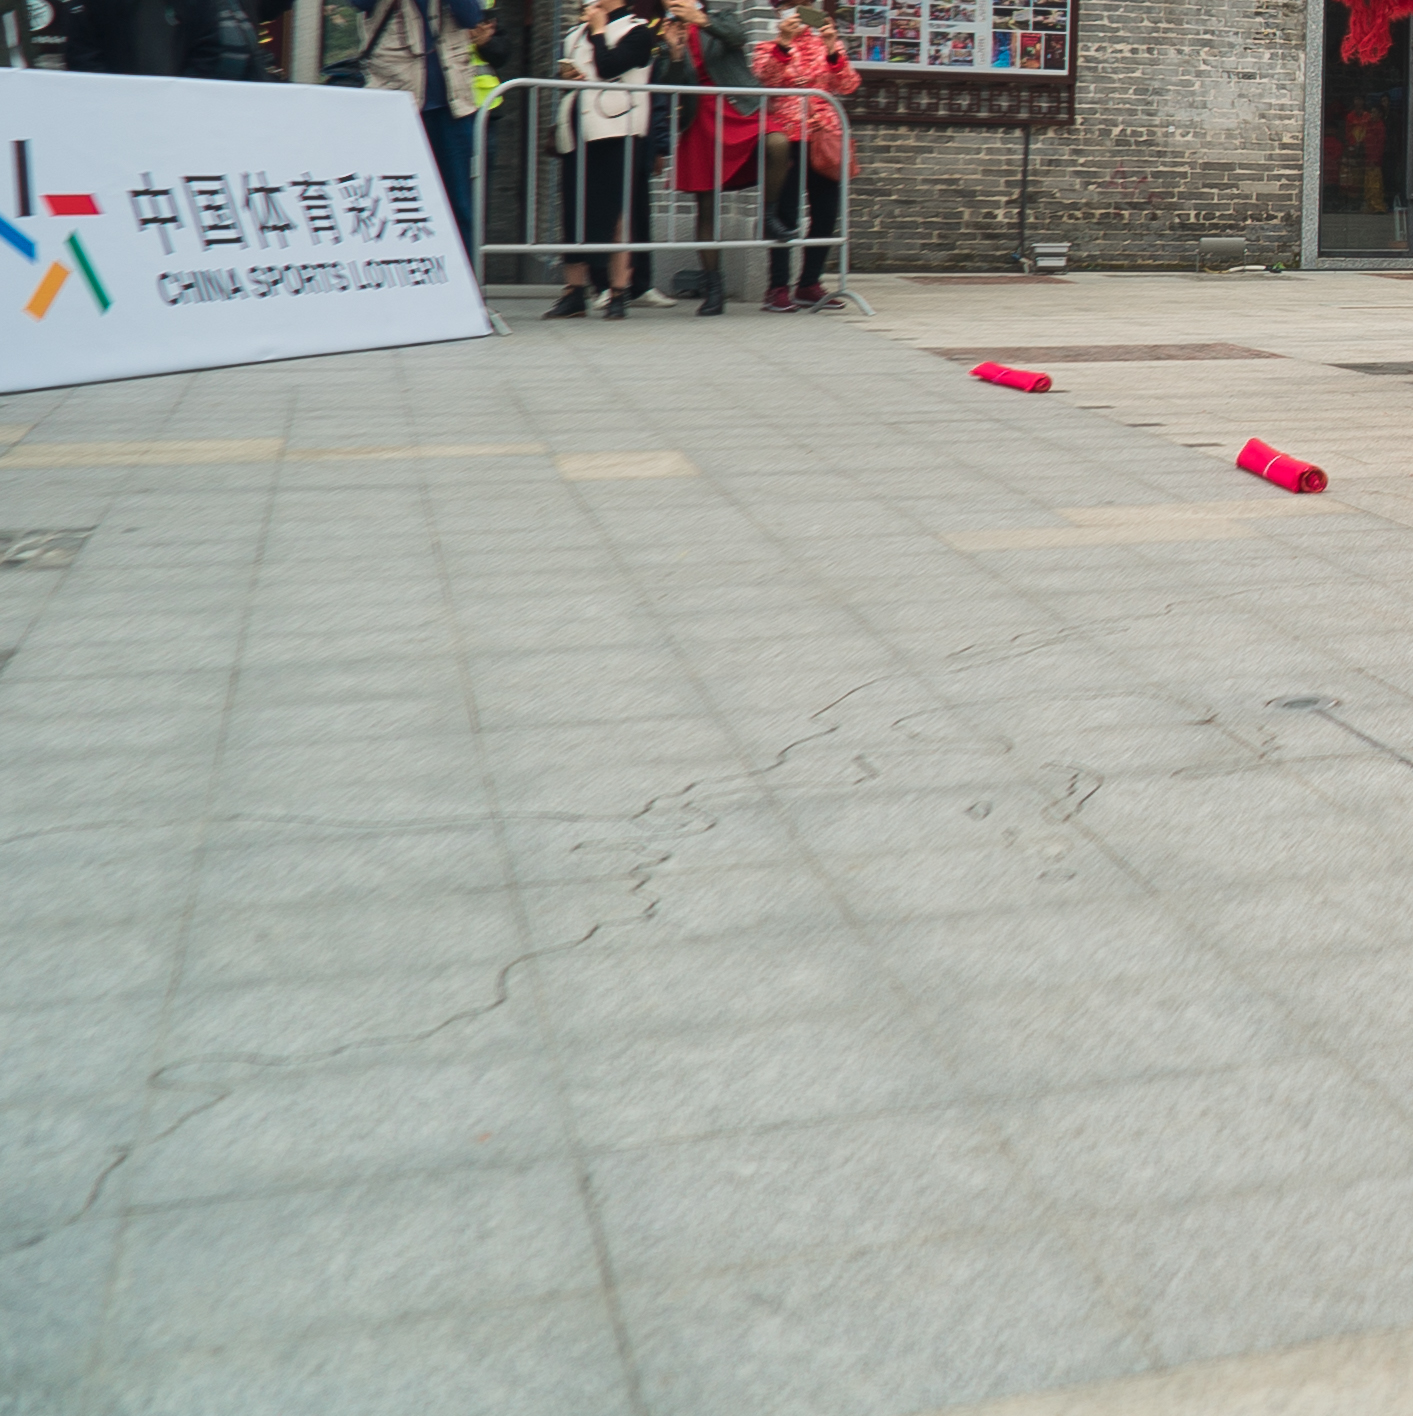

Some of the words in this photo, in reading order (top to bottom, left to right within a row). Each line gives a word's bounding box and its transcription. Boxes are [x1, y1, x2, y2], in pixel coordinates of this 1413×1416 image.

[127, 171, 436, 255] 中国体育彩票
[156, 268, 249, 306] CHINA
[247, 260, 349, 299] SPORTS
[347, 255, 448, 292] LOTTERY
